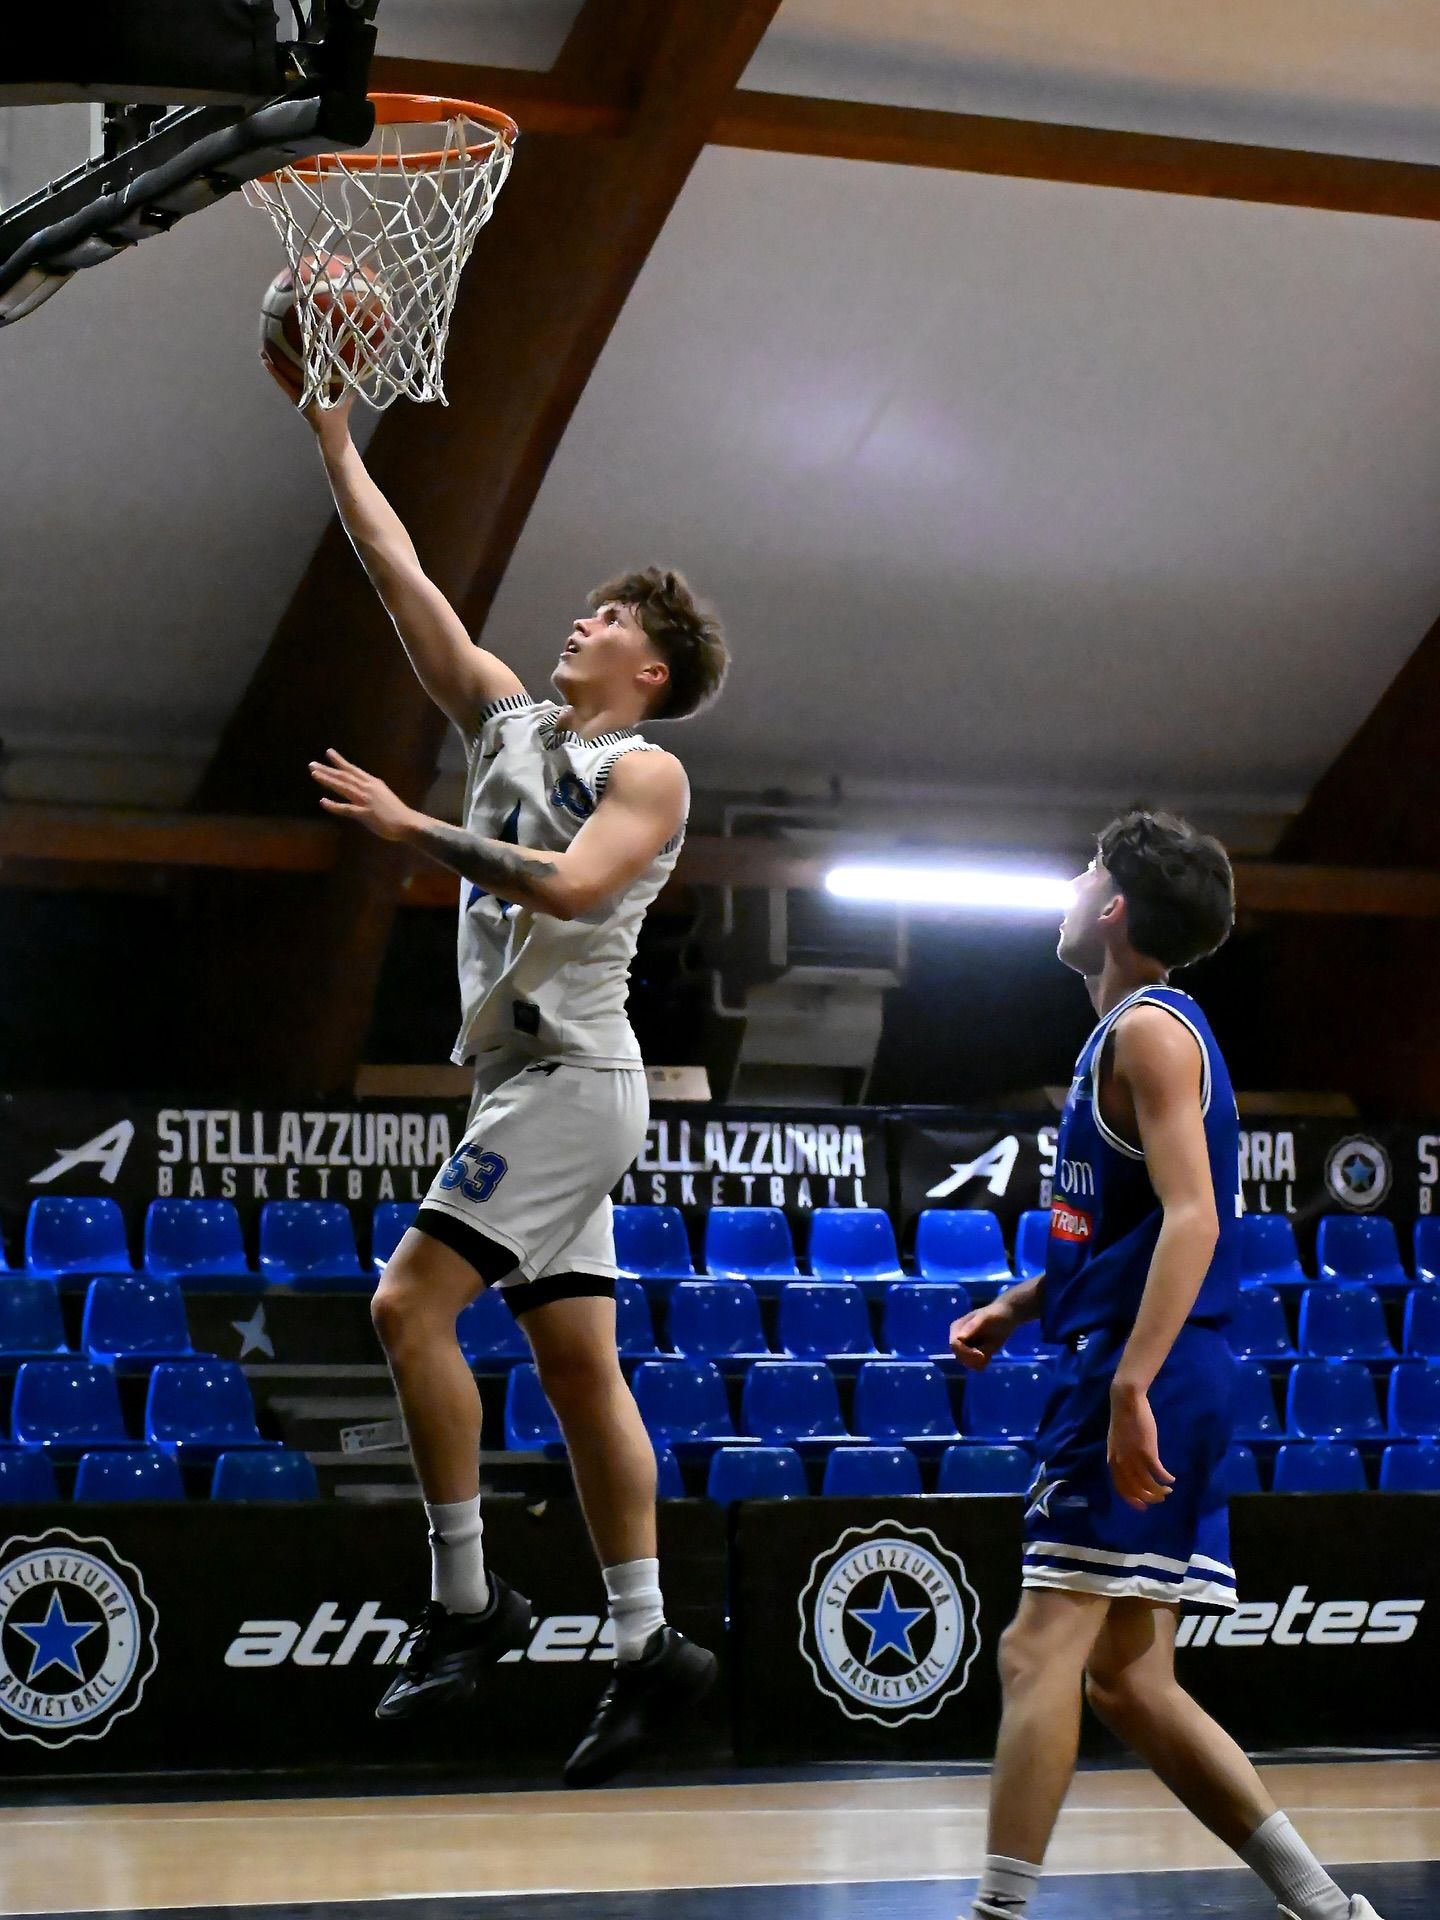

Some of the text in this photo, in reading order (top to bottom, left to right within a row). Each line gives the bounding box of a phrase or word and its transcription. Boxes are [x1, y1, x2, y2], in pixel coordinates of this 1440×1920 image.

[157, 1109, 451, 1167] STELLAZZURRA
[637, 1120, 867, 1178] ELLAZZURRA
[157, 1166, 423, 1200] BASKETBAL
[440, 1143, 508, 1203] 53
[621, 1172, 868, 1209] ASKETBALL
[0, 1559, 127, 1622] ELLAZZURRA
[826, 1549, 951, 1608] STELLAZZURRA
[1175, 1585, 1425, 1647] letes
[838, 1657, 945, 1697] BASKETBALL
